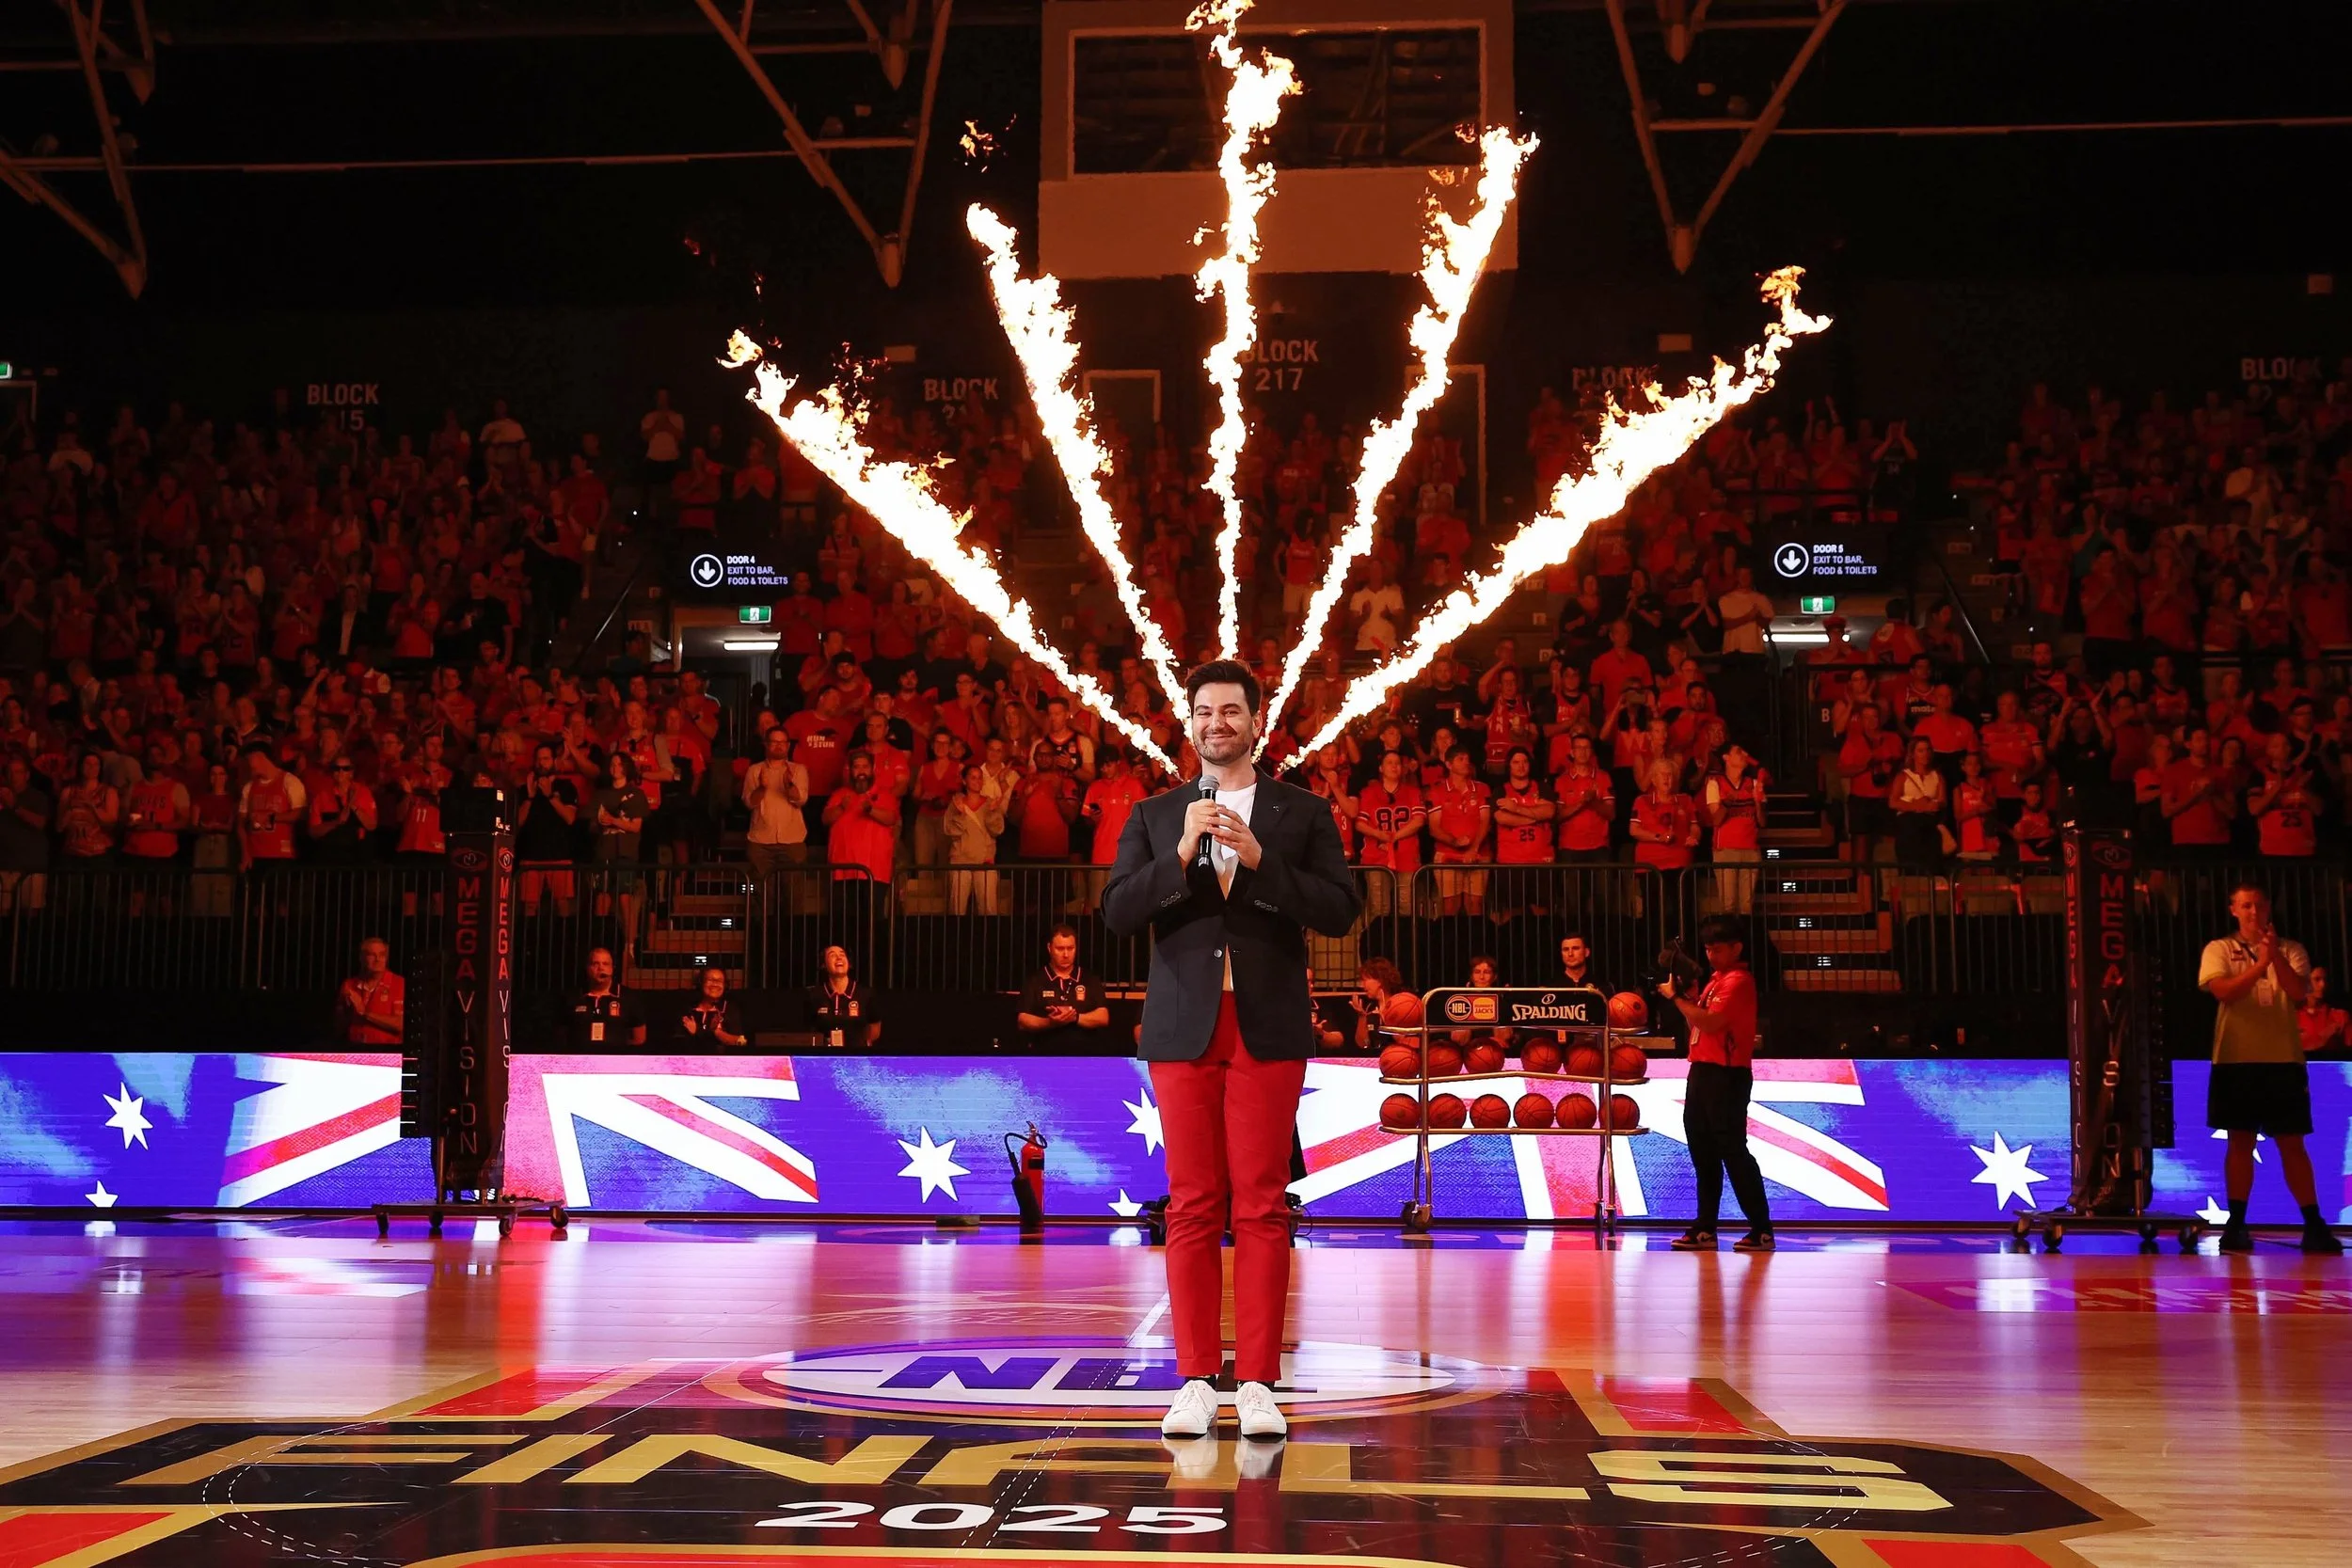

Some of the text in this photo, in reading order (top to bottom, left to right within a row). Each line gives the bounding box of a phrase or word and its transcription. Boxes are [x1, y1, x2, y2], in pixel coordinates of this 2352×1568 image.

[2241, 357, 2323, 380] BLO
[1254, 367, 1304, 391] 217
[306, 383, 379, 406] BLOCK
[1813, 545, 1836, 553] DOOR
[726, 556, 750, 564] DOOR
[1813, 556, 1831, 564] EXIT
[727, 566, 743, 575] EXIT
[745, 566, 755, 575] TO
[1813, 566, 1877, 575] FOOD & TOILETS
[757, 577, 788, 585] TOILETS
[1519, 829, 1535, 841] 25
[455, 876, 482, 981] MEGA
[497, 876, 510, 981] MEGA
[2100, 872, 2126, 989] MEGA
[1452, 1003, 1467, 1014] NBL
[1511, 1004, 1586, 1022] SPALDING
[455, 990, 478, 1155] VISION
[115, 1433, 1953, 1512] FINALS
[754, 1500, 1228, 1535] 2025
